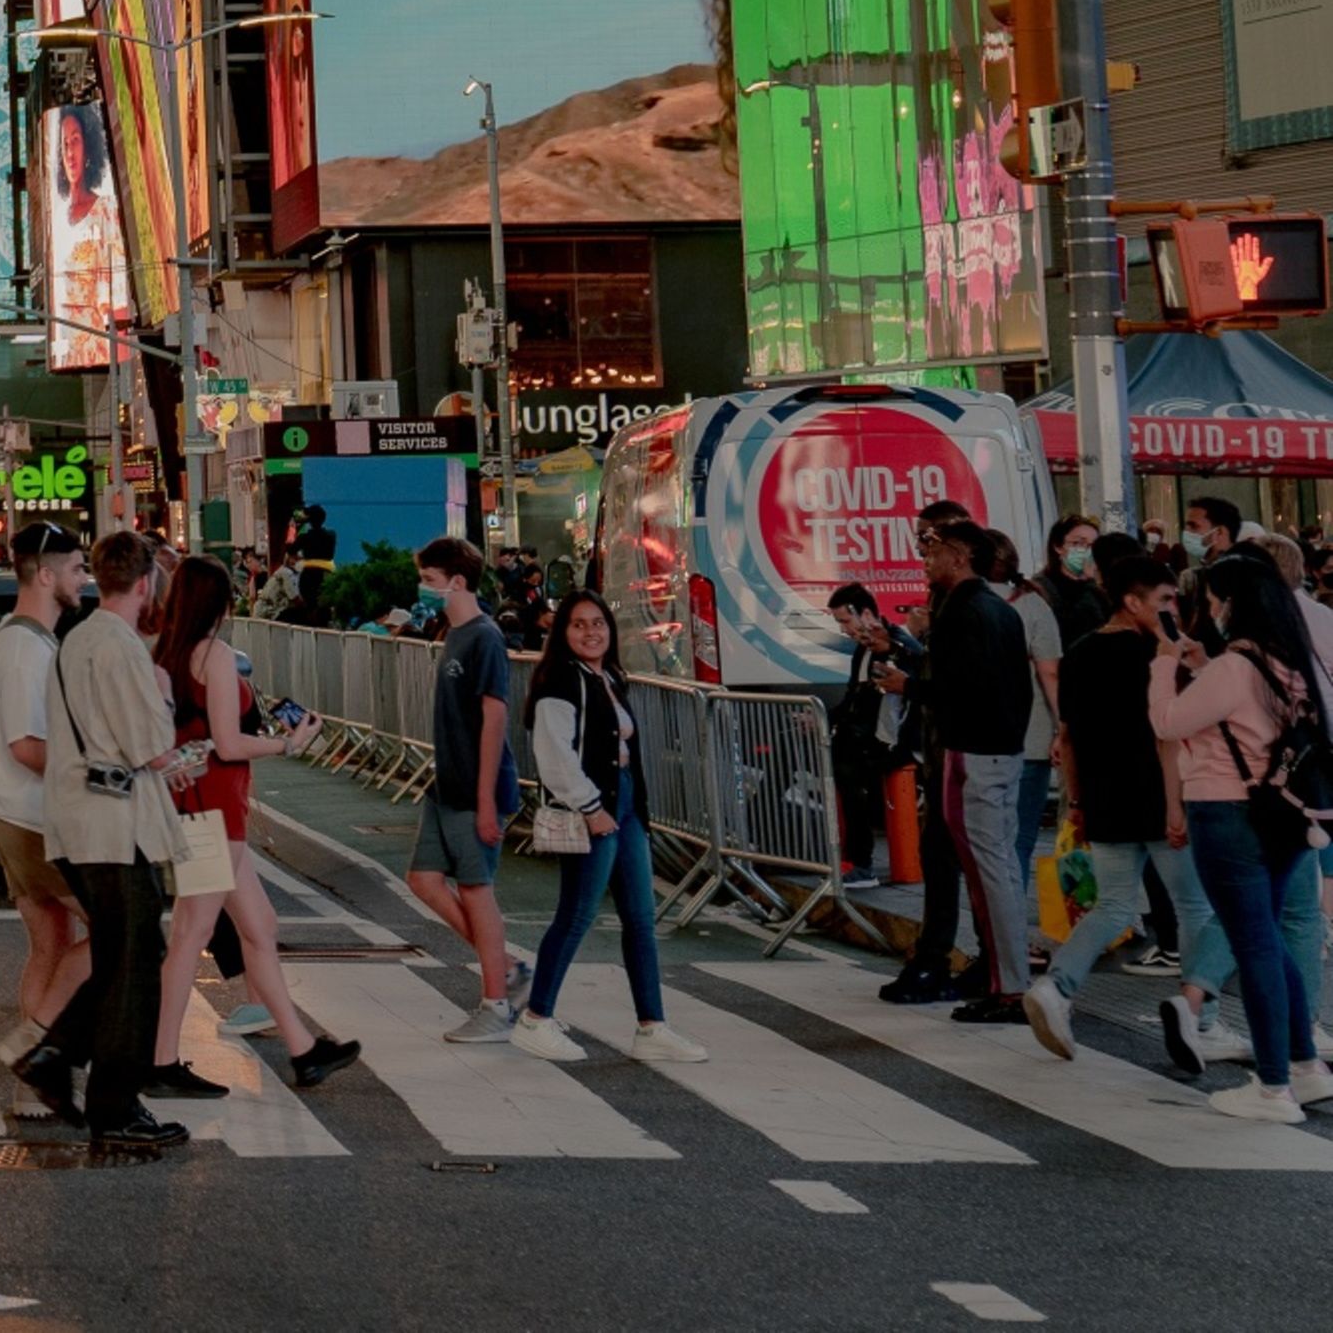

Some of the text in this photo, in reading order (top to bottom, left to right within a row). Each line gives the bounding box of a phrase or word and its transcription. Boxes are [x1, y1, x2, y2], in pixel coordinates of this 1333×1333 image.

[377, 421, 436, 436] VISITOR
[516, 392, 673, 443] unglas
[378, 436, 448, 452] SERVICES
[1130, 421, 1285, 460] COVID-19
[794, 464, 948, 513] COVID-19
[804, 515, 924, 563] TESTIN
